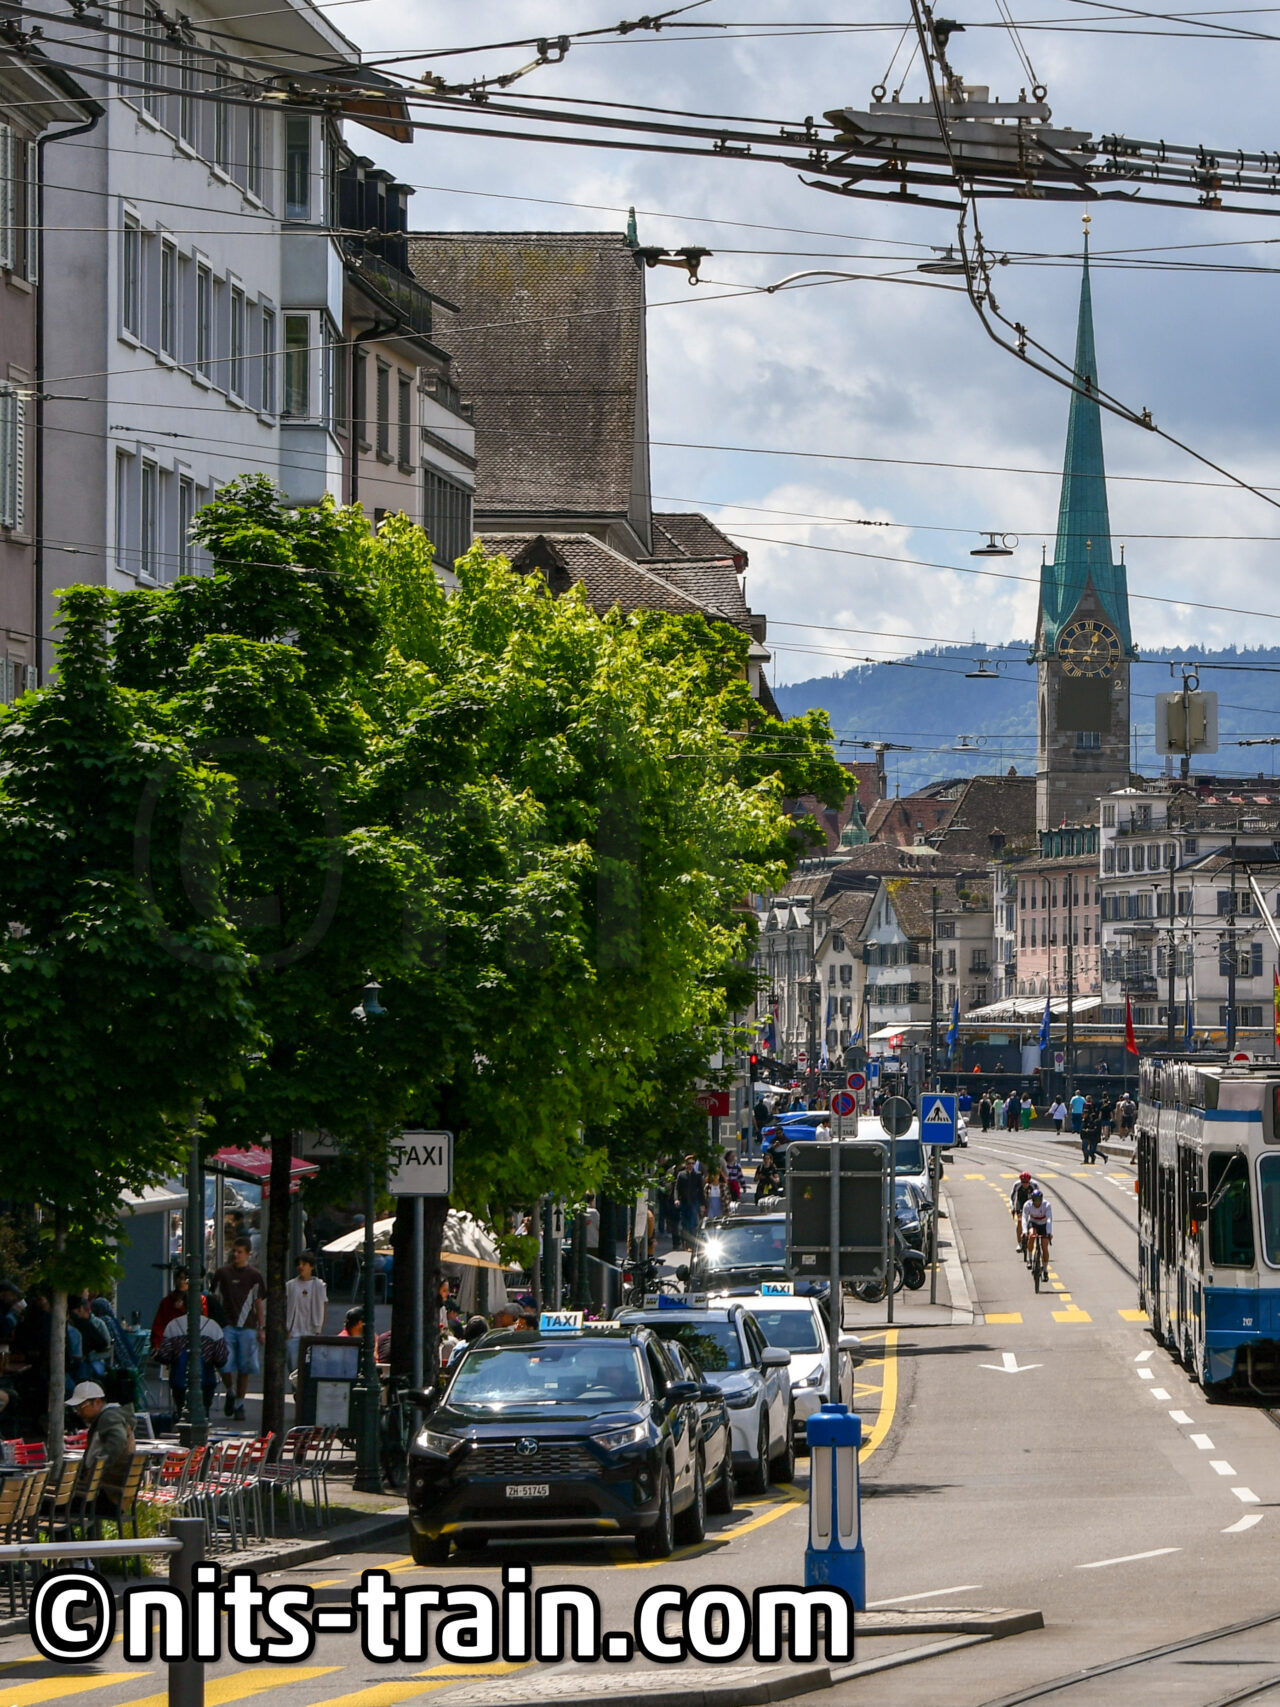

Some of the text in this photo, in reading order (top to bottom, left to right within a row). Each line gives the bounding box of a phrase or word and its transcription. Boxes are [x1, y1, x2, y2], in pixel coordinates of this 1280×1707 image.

[393, 1145, 443, 1166] TAXI
[765, 1284, 790, 1294] TAXI
[664, 1297, 687, 1305] TAXI
[545, 1314, 577, 1327] TAXI
